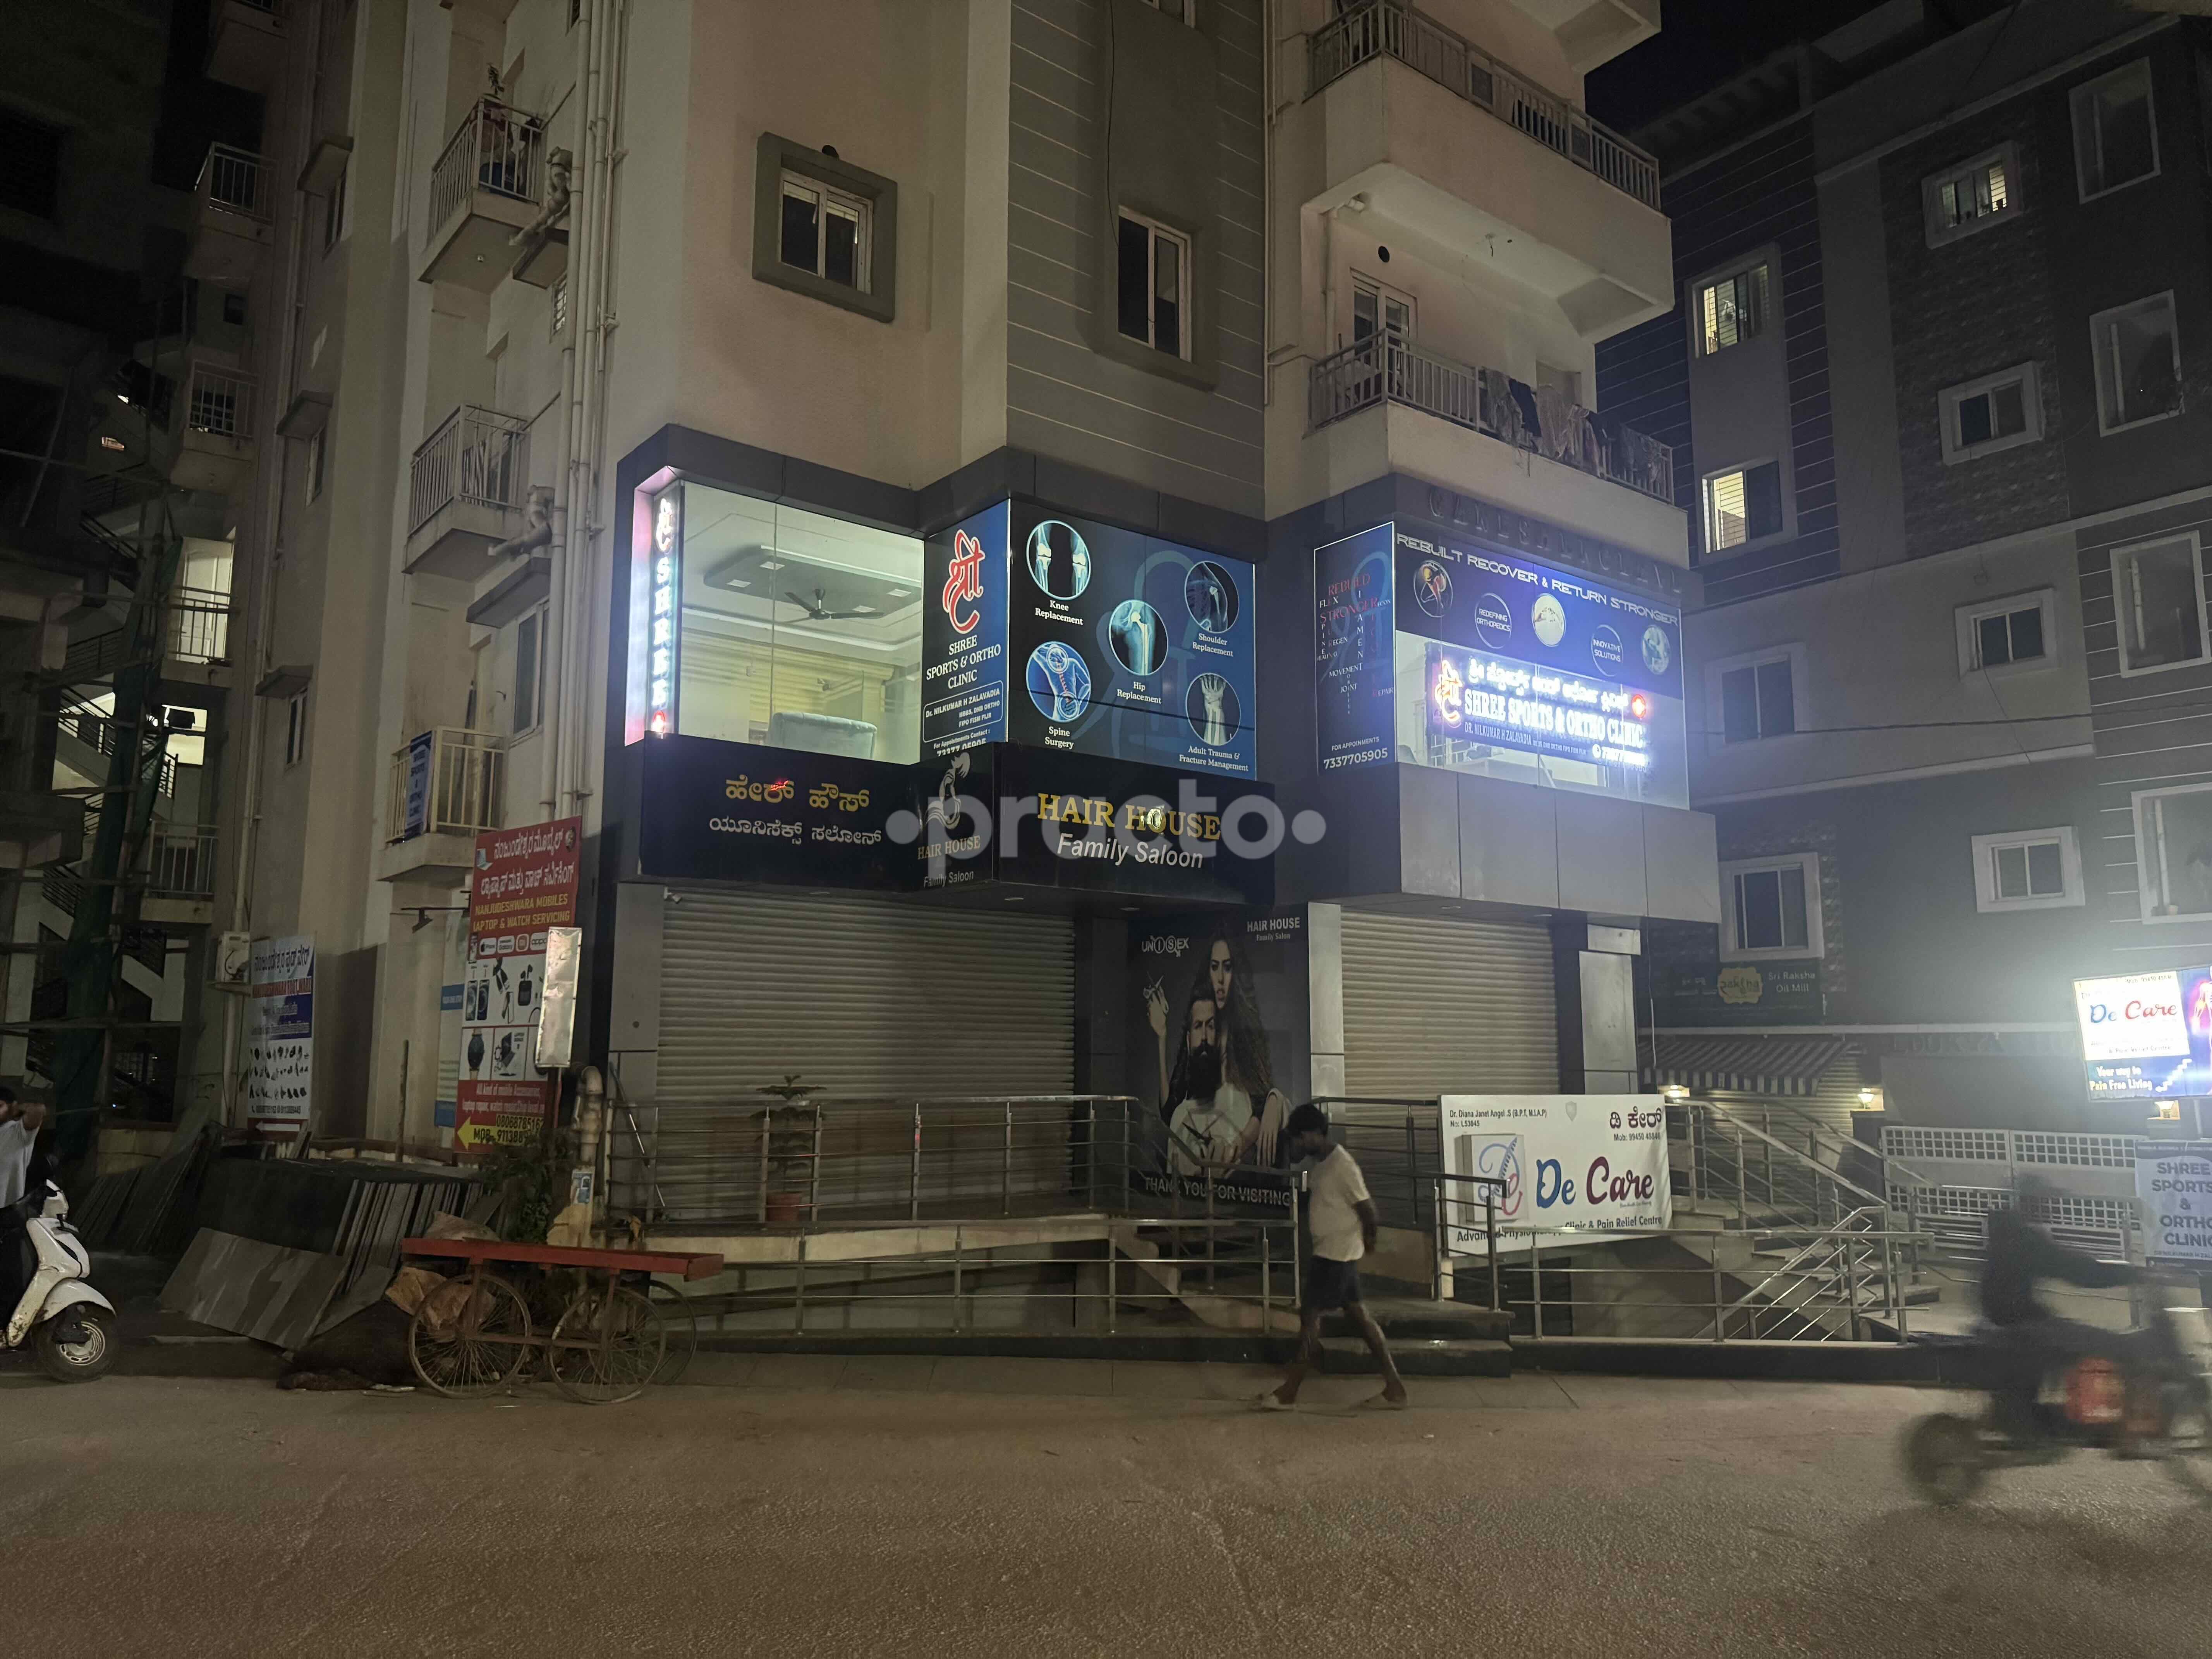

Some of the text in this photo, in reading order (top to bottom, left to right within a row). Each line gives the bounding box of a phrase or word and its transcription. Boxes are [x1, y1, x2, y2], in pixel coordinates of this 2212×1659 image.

[1396, 533, 1678, 626] REBUILT RECOVER & RETURN STRONGER
[1050, 600, 1069, 611] Knee
[1035, 607, 1084, 625] Replacement
[1479, 608, 1508, 622] REDEFINING
[1477, 617, 1510, 632] ORTHOPEDICS
[949, 635, 977, 655] SHREE
[1198, 633, 1228, 646] Shoulder
[1593, 639, 1621, 653] INNOVATIVE
[1192, 642, 1233, 657] Replacement
[1594, 650, 1621, 662] SOLUTIONS
[926, 644, 1001, 680] SPORTS & ORTHO
[1329, 663, 1363, 678] MOVEMENT
[948, 670, 977, 689] CLINIC
[1133, 682, 1146, 692] Hip
[1341, 684, 1357, 693] JOINT
[934, 700, 962, 715] NILKUMAR
[969, 688, 1000, 704] ZALAVADIA
[1117, 689, 1162, 704] Replacement
[984, 700, 1000, 711] ORTHO
[1465, 689, 1506, 721] SHREE
[1508, 697, 1554, 731] SPORTS
[1566, 709, 1606, 741] ORTHO
[1607, 718, 1643, 748] CLINIC
[1049, 726, 1070, 737] Spine
[1465, 722, 1473, 733] DR.
[1474, 724, 1501, 739] NILKUMAR
[1501, 729, 1505, 740] H
[1045, 737, 1074, 750] Surgery
[1342, 737, 1379, 749] APPOINMENTS
[1188, 745, 1206, 755] Adult
[1208, 748, 1232, 759] Trauma
[1323, 748, 1388, 769] 7337705905
[1179, 754, 1249, 772] Fracture Management
[1037, 793, 1221, 840] HAIR HOUSE
[917, 835, 981, 860] HAIR HOUSE
[1058, 833, 1202, 868] Family Saloon
[924, 870, 974, 888] Family Saloon
[536, 893, 568, 908] MOBILES
[474, 919, 498, 932] LAPTOP
[508, 915, 530, 927] WATCH
[532, 910, 570, 924] SERVICING
[1247, 917, 1300, 932] HAIR HOUSE
[1256, 934, 1274, 942] Family
[1769, 971, 1816, 980] Sri Raksha
[1776, 984, 1809, 993] Oil Mill
[2090, 1000, 2177, 1023] De Care
[2096, 1065, 2114, 1077] Your
[2132, 1065, 2142, 1075] to
[2089, 1079, 2153, 1091] Pain Free Living
[1491, 1110, 1505, 1118] Angel
[1628, 1106, 1661, 1128] ಕೇರ್
[2157, 1162, 2210, 1175] SHREE
[1536, 1156, 1654, 1209] De Care
[1239, 1187, 1290, 1206] VISITING
[2179, 1198, 2191, 1210] &
[1597, 1219, 1614, 1228] Pain
[1616, 1215, 1637, 1227] Relief
[1639, 1215, 1662, 1225] Centre
[1457, 1227, 1501, 1242] Advand
